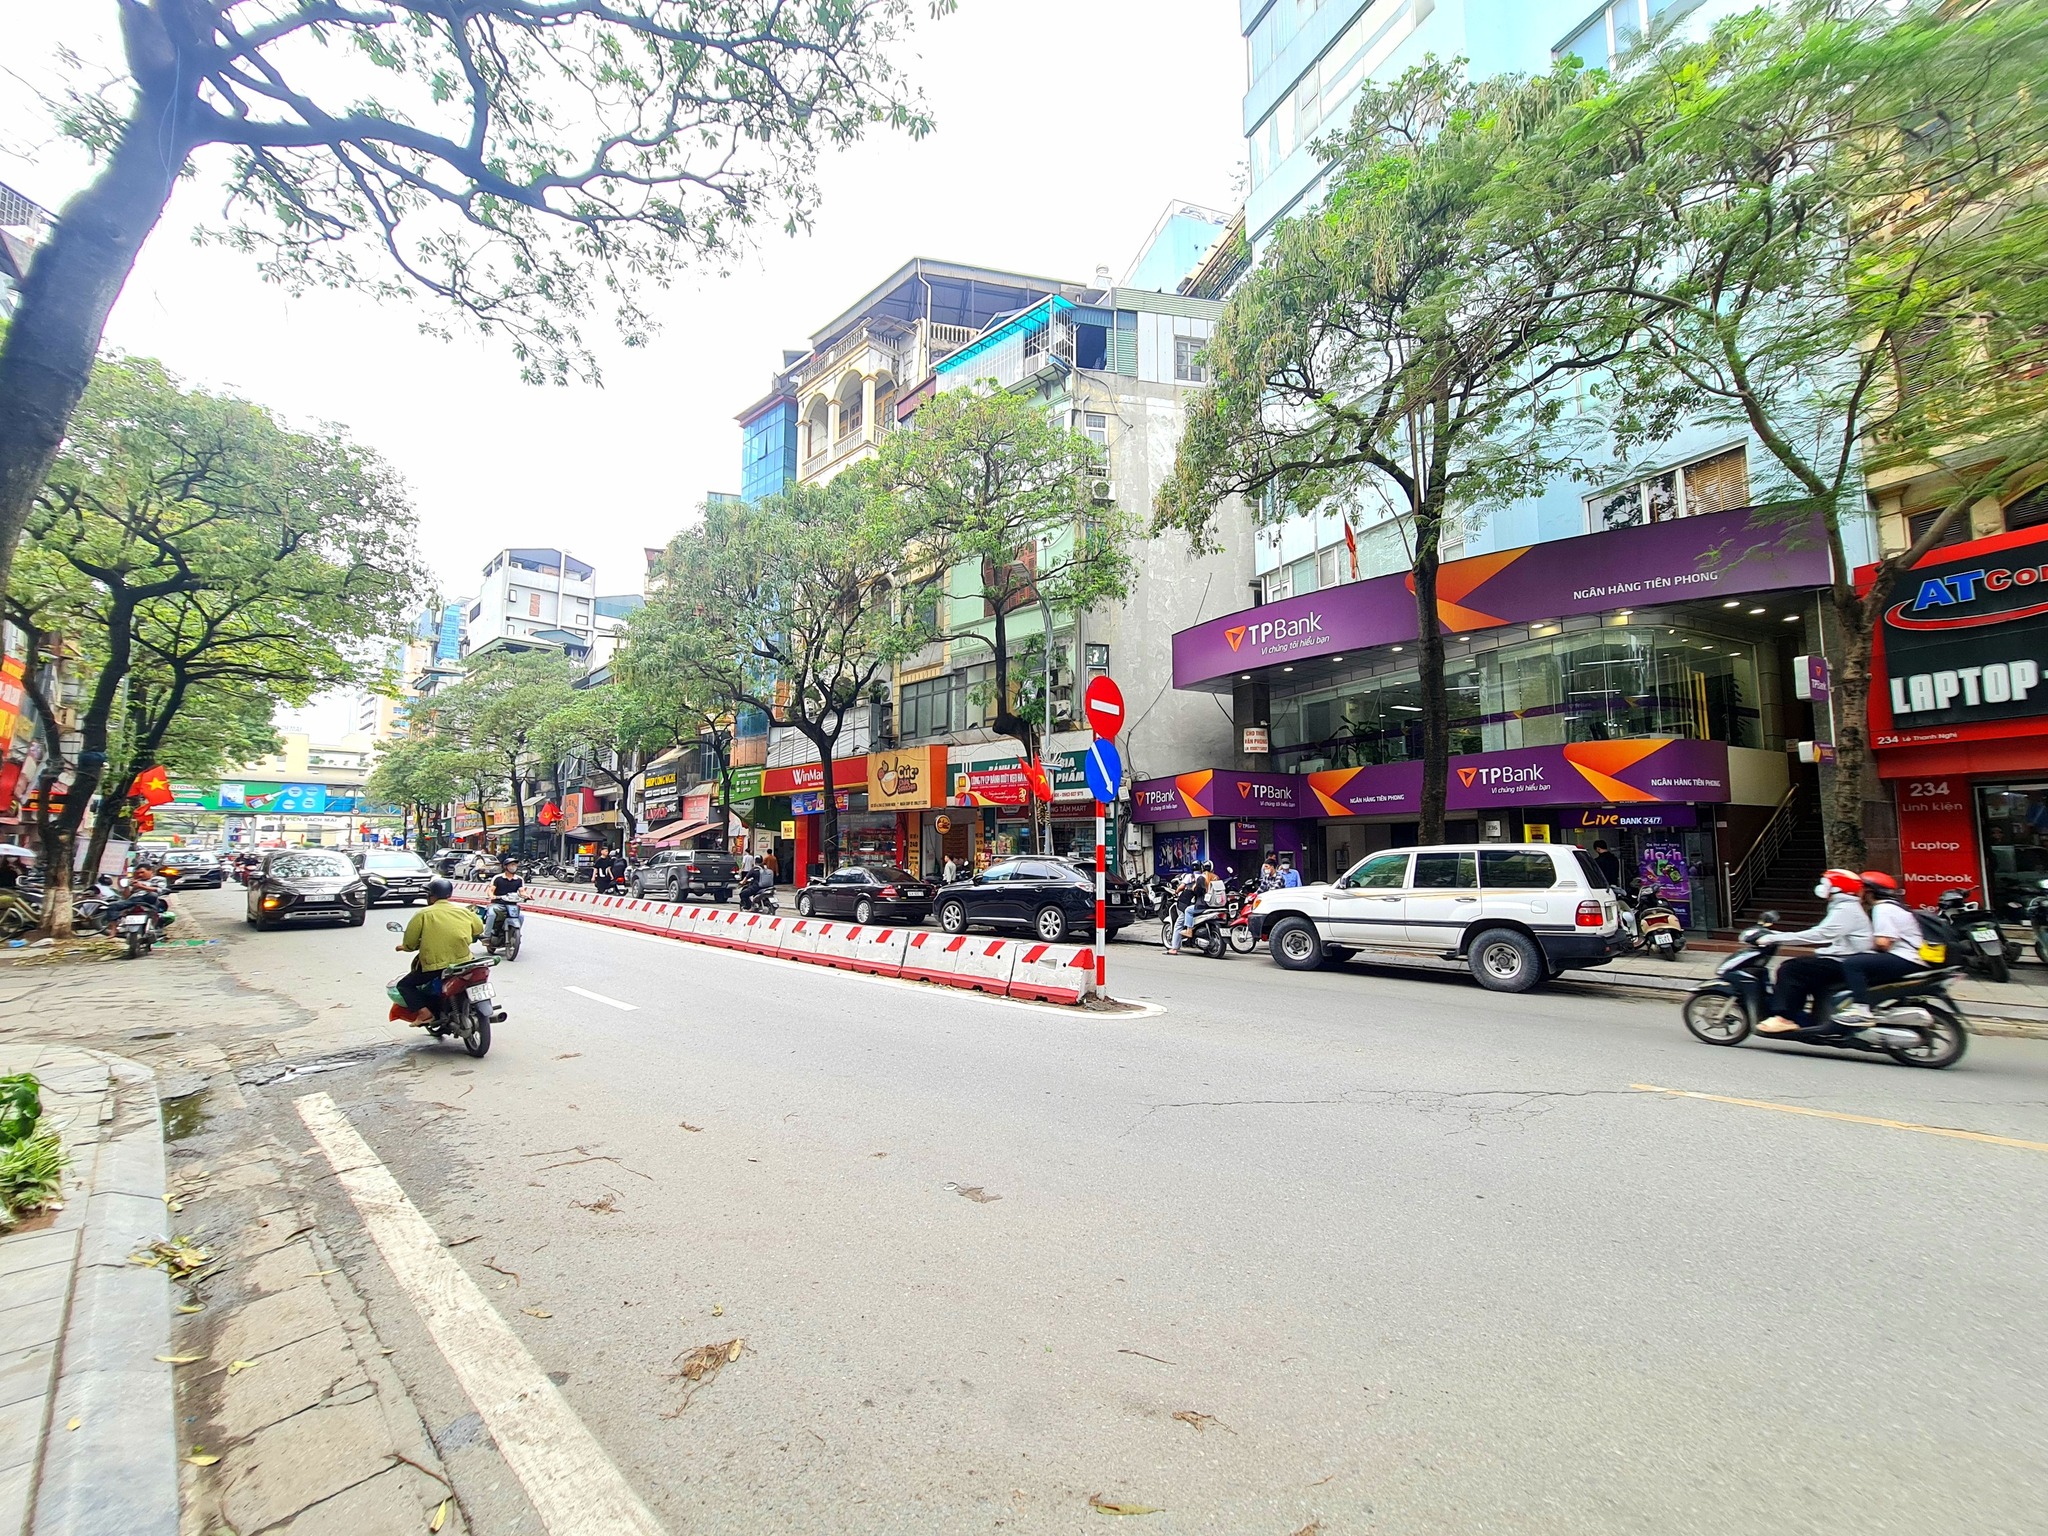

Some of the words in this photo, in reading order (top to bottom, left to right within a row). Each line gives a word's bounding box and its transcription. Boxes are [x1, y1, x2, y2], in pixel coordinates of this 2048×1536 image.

[1573, 586, 1606, 600] NGÂN
[1608, 581, 1641, 595] HÀNG
[1644, 576, 1671, 590] TIÊN
[1674, 571, 1718, 586] PHONG
[1248, 611, 1322, 645] TPBank
[1268, 643, 1288, 655] chúng
[1289, 640, 1299, 650] tôi
[1300, 635, 1315, 647] hiểu
[1316, 635, 1330, 645] bạn
[1890, 659, 2039, 714] LAPTOP
[1877, 735, 1899, 745] 234
[1056, 767, 1085, 783] PHẨM
[1478, 763, 1544, 784] TPBank
[1498, 786, 1515, 794] chúng
[1651, 777, 1673, 786] NGÂN
[1673, 777, 1692, 786] HÀNG
[1692, 778, 1705, 786] TIÊN
[1705, 779, 1721, 787] PHONG
[1909, 781, 1950, 797] 234
[1145, 789, 1175, 805] TPBank
[1252, 784, 1292, 800] TPBank
[1350, 796, 1362, 804] NGÂN
[1902, 802, 1928, 812] Linh
[1932, 801, 1963, 812] kiện
[1582, 810, 1619, 826] Live
[1620, 817, 1642, 825] BANK
[1643, 816, 1662, 825] 24/7
[1911, 841, 1960, 851] Laptop
[1904, 873, 1973, 883] Macbook
